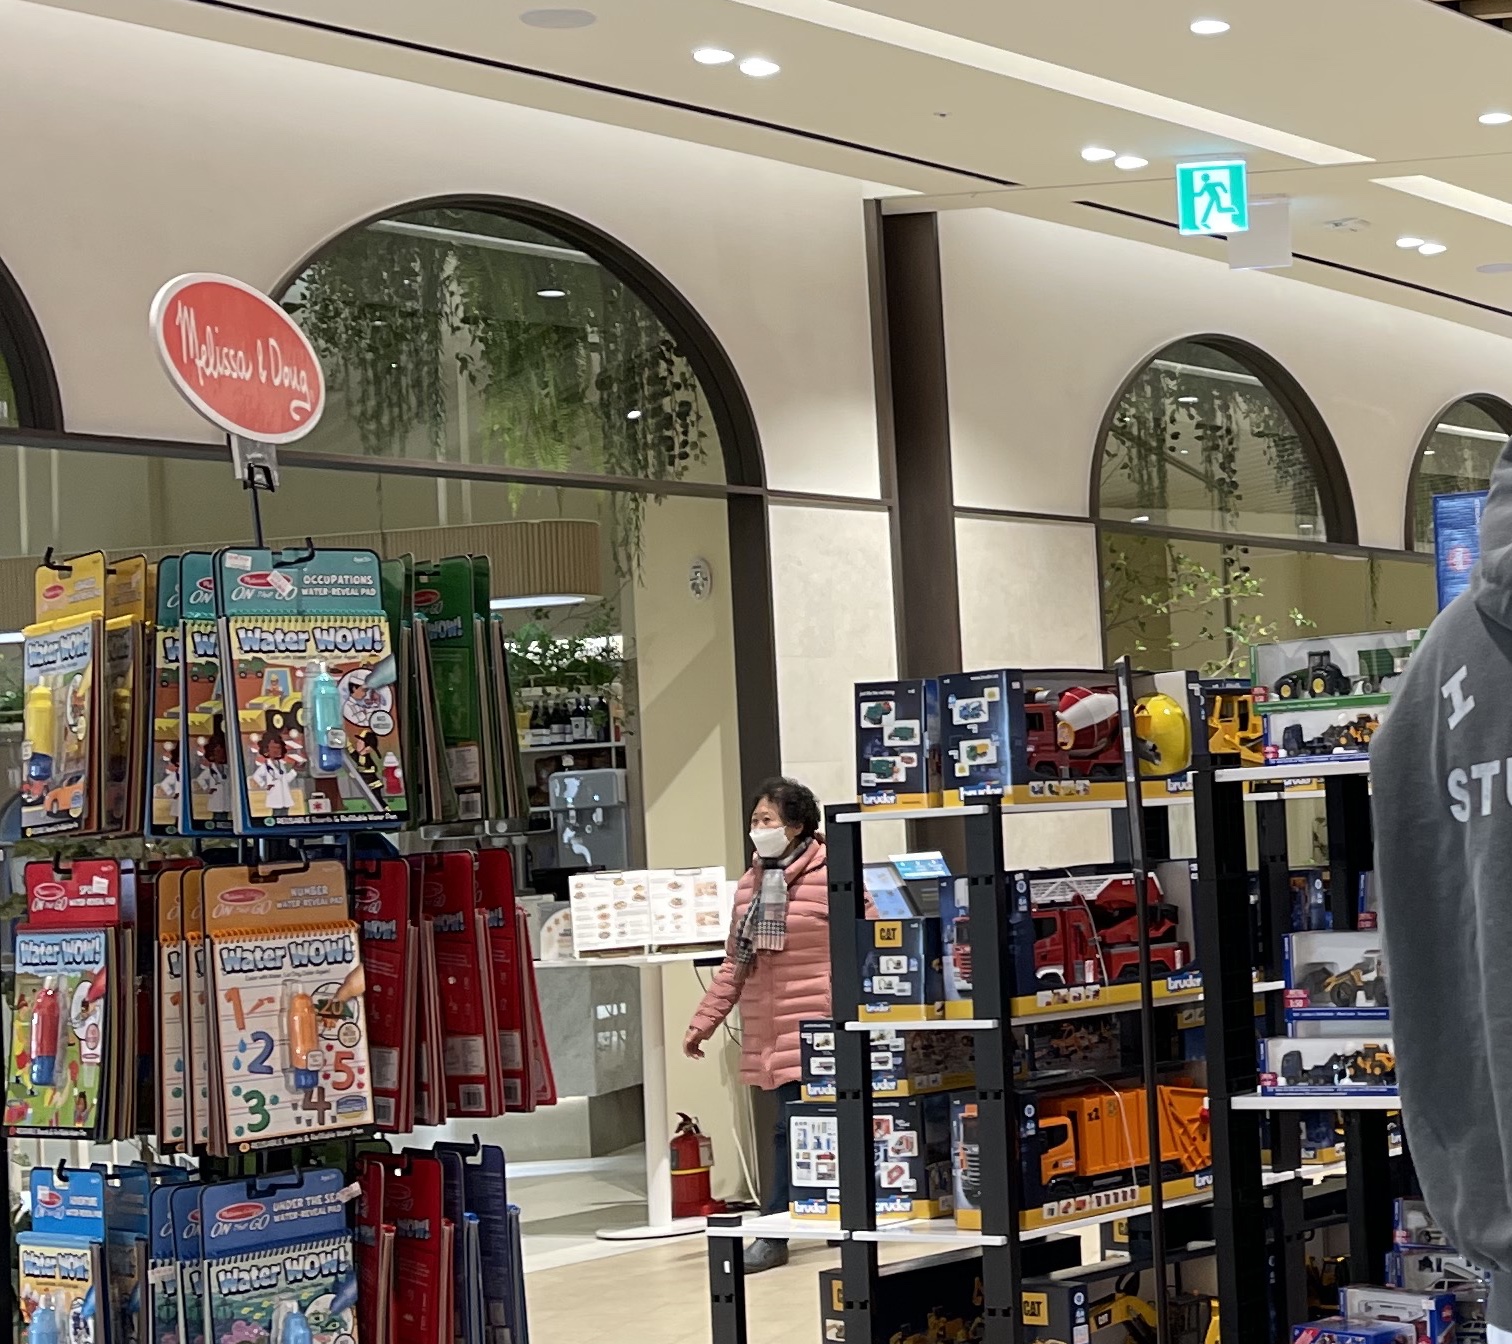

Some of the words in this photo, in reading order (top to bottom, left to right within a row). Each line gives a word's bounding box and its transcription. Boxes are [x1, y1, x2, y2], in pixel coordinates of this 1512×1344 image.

[176, 300, 252, 386] Melissa
[268, 338, 311, 421] Doug
[302, 574, 374, 586] OCCUPATIONS
[360, 587, 377, 597] PAD
[236, 626, 310, 654] Water
[312, 624, 385, 654] WOW!
[863, 792, 896, 806] bruder
[290, 884, 328, 897] NUMBER
[879, 927, 898, 941] CAT
[220, 945, 287, 975] Water
[288, 934, 357, 969] WOW!
[247, 1030, 275, 1075] 2
[331, 1050, 356, 1091] 5
[243, 1090, 271, 1133] 3
[302, 1087, 332, 1126] 4
[272, 1196, 304, 1213] UNDER
[306, 1193, 323, 1207] THE
[248, 1213, 271, 1232] GO
[216, 1261, 282, 1298] Water
[283, 1245, 348, 1285] WOW!
[1023, 1298, 1042, 1318] CAT
